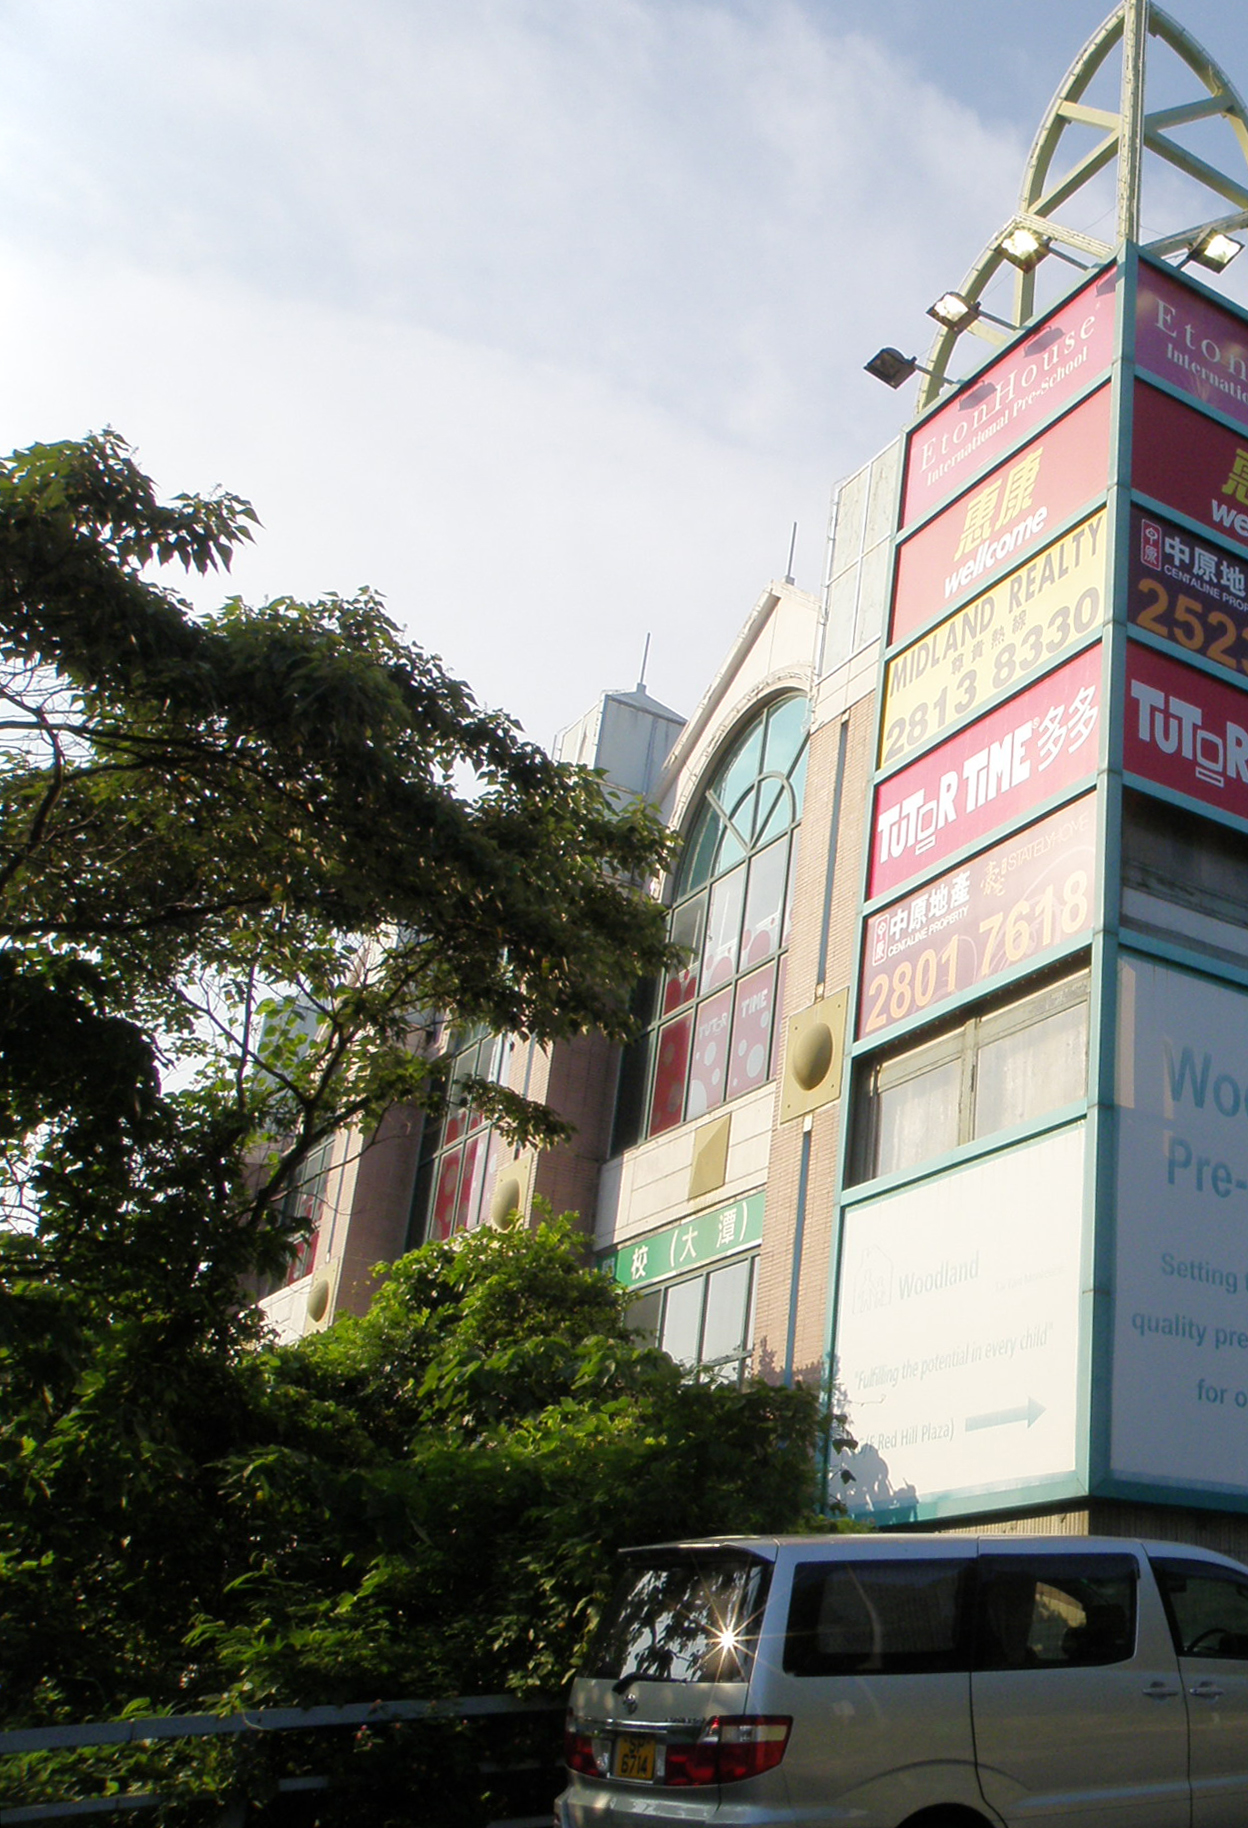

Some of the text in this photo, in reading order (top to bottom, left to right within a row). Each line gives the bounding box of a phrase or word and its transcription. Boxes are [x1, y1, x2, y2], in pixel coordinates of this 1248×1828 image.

[920, 315, 1097, 473] EtonHouse
[927, 346, 1088, 487] International Pre-School
[954, 446, 1044, 562] 惠康
[943, 506, 1048, 598] wellcome
[1164, 565, 1220, 599] CENTALINE
[889, 516, 1103, 698] MIDLAND REALTY
[884, 586, 1101, 765] 2813 8330
[1037, 685, 1099, 772] 多多
[877, 720, 1034, 864] TUTOR TIME
[888, 905, 969, 957] CENTALINE PROPERTY
[889, 871, 971, 942] 中原地產
[865, 870, 1088, 1035] 2801 7618
[899, 1250, 980, 1300] Woodland
[1161, 1252, 1238, 1295] Setting
[902, 1359, 918, 1381] the
[920, 1343, 969, 1382] potential
[971, 1341, 982, 1363] in
[985, 1337, 1017, 1360] every
[1132, 1311, 1207, 1347] quality
[1197, 1378, 1228, 1404] for
[878, 1429, 898, 1450] Red
[901, 1425, 918, 1446] Hill
[921, 1417, 954, 1442] Plaza)
[621, 1754, 648, 1775] 6714
